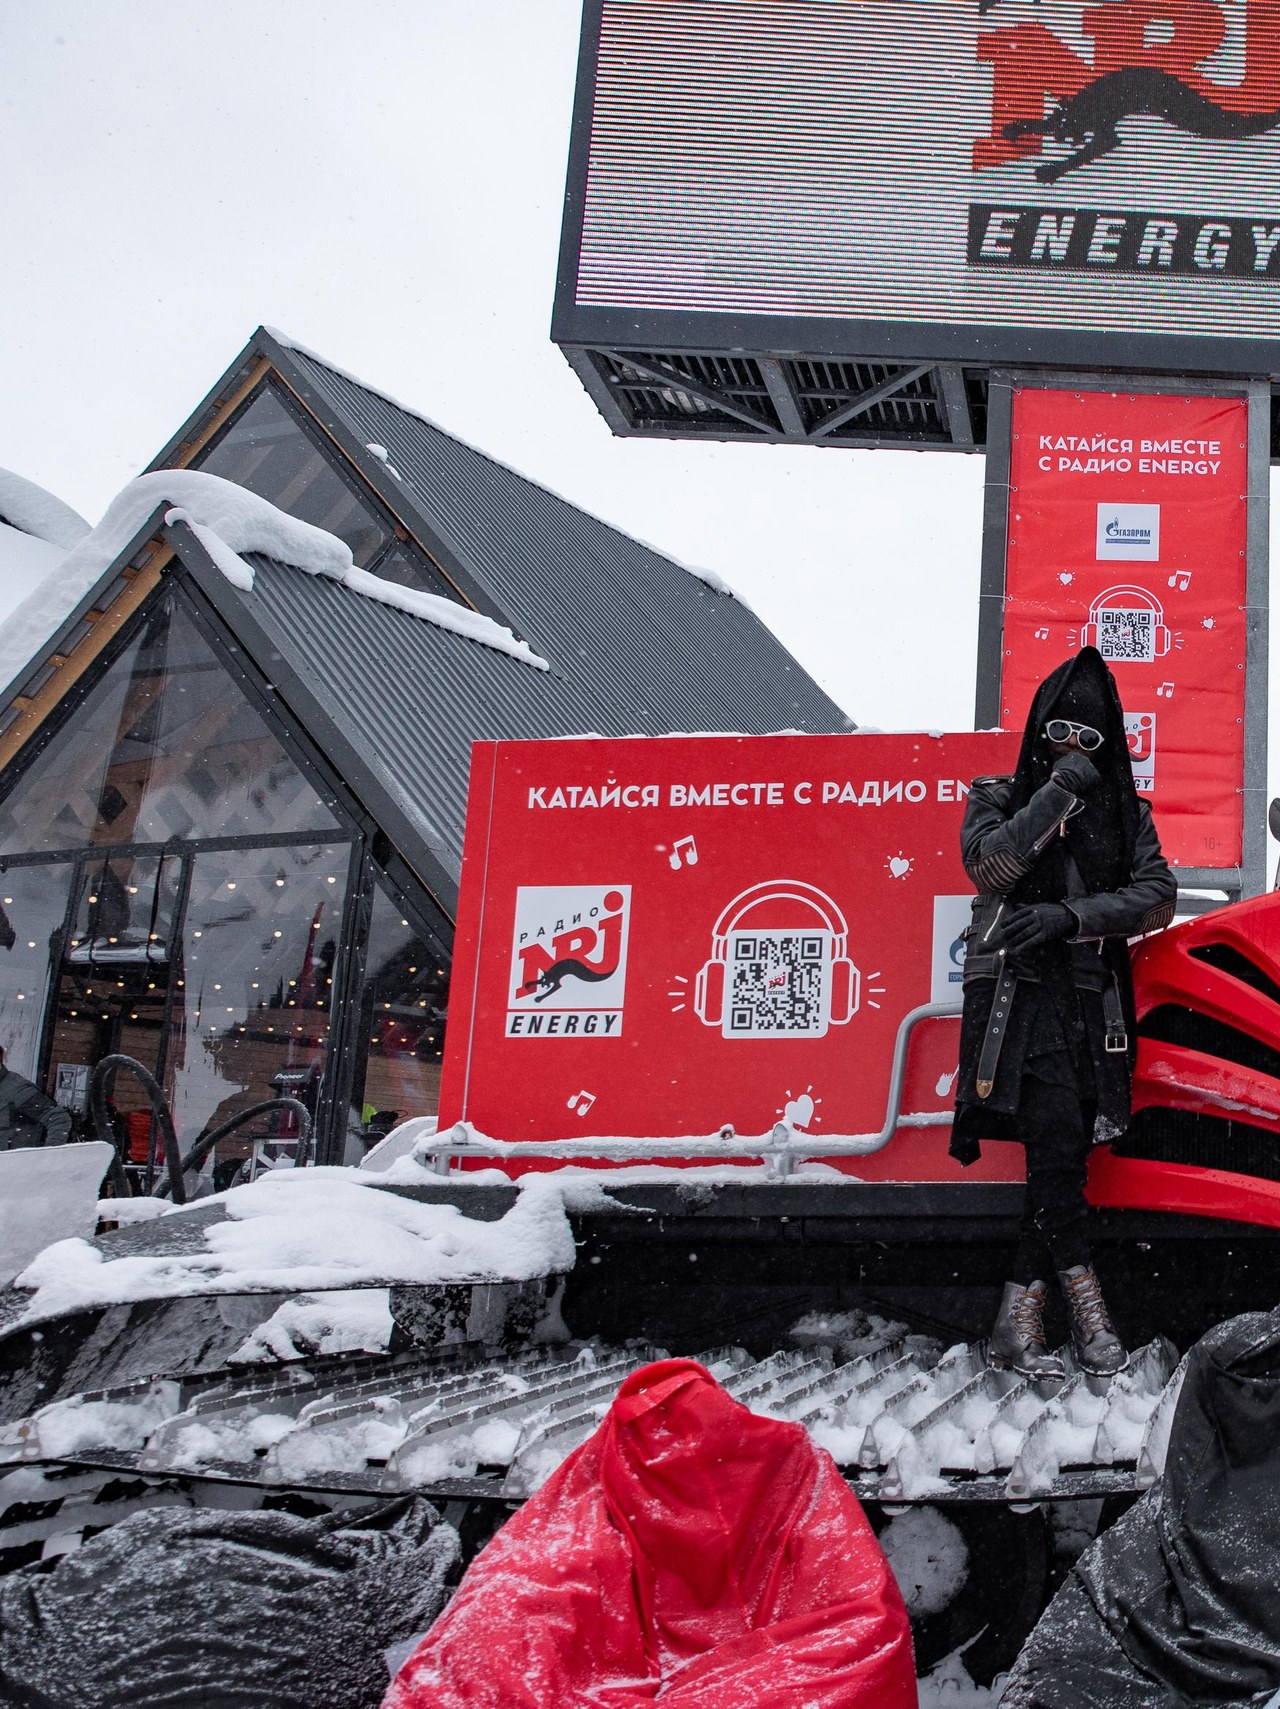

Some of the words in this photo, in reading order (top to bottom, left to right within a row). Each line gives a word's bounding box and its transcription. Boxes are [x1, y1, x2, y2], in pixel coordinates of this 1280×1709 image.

[1039, 433, 1133, 453] КАТАЙСЯ
[1140, 439, 1221, 455] ВМЕСТЕ
[1038, 456, 1052, 471] С
[1058, 457, 1132, 474] РАДИО
[1138, 458, 1222, 475] ENERGY
[527, 779, 659, 809] КАТАЙСЯ
[669, 783, 784, 806] ВМЕСТЕ
[793, 782, 812, 805] С
[822, 780, 927, 806] РАДИО
[1203, 837, 1223, 850] 16+
[519, 906, 599, 944] РАДИО
[510, 1014, 618, 1034] ENERGY
